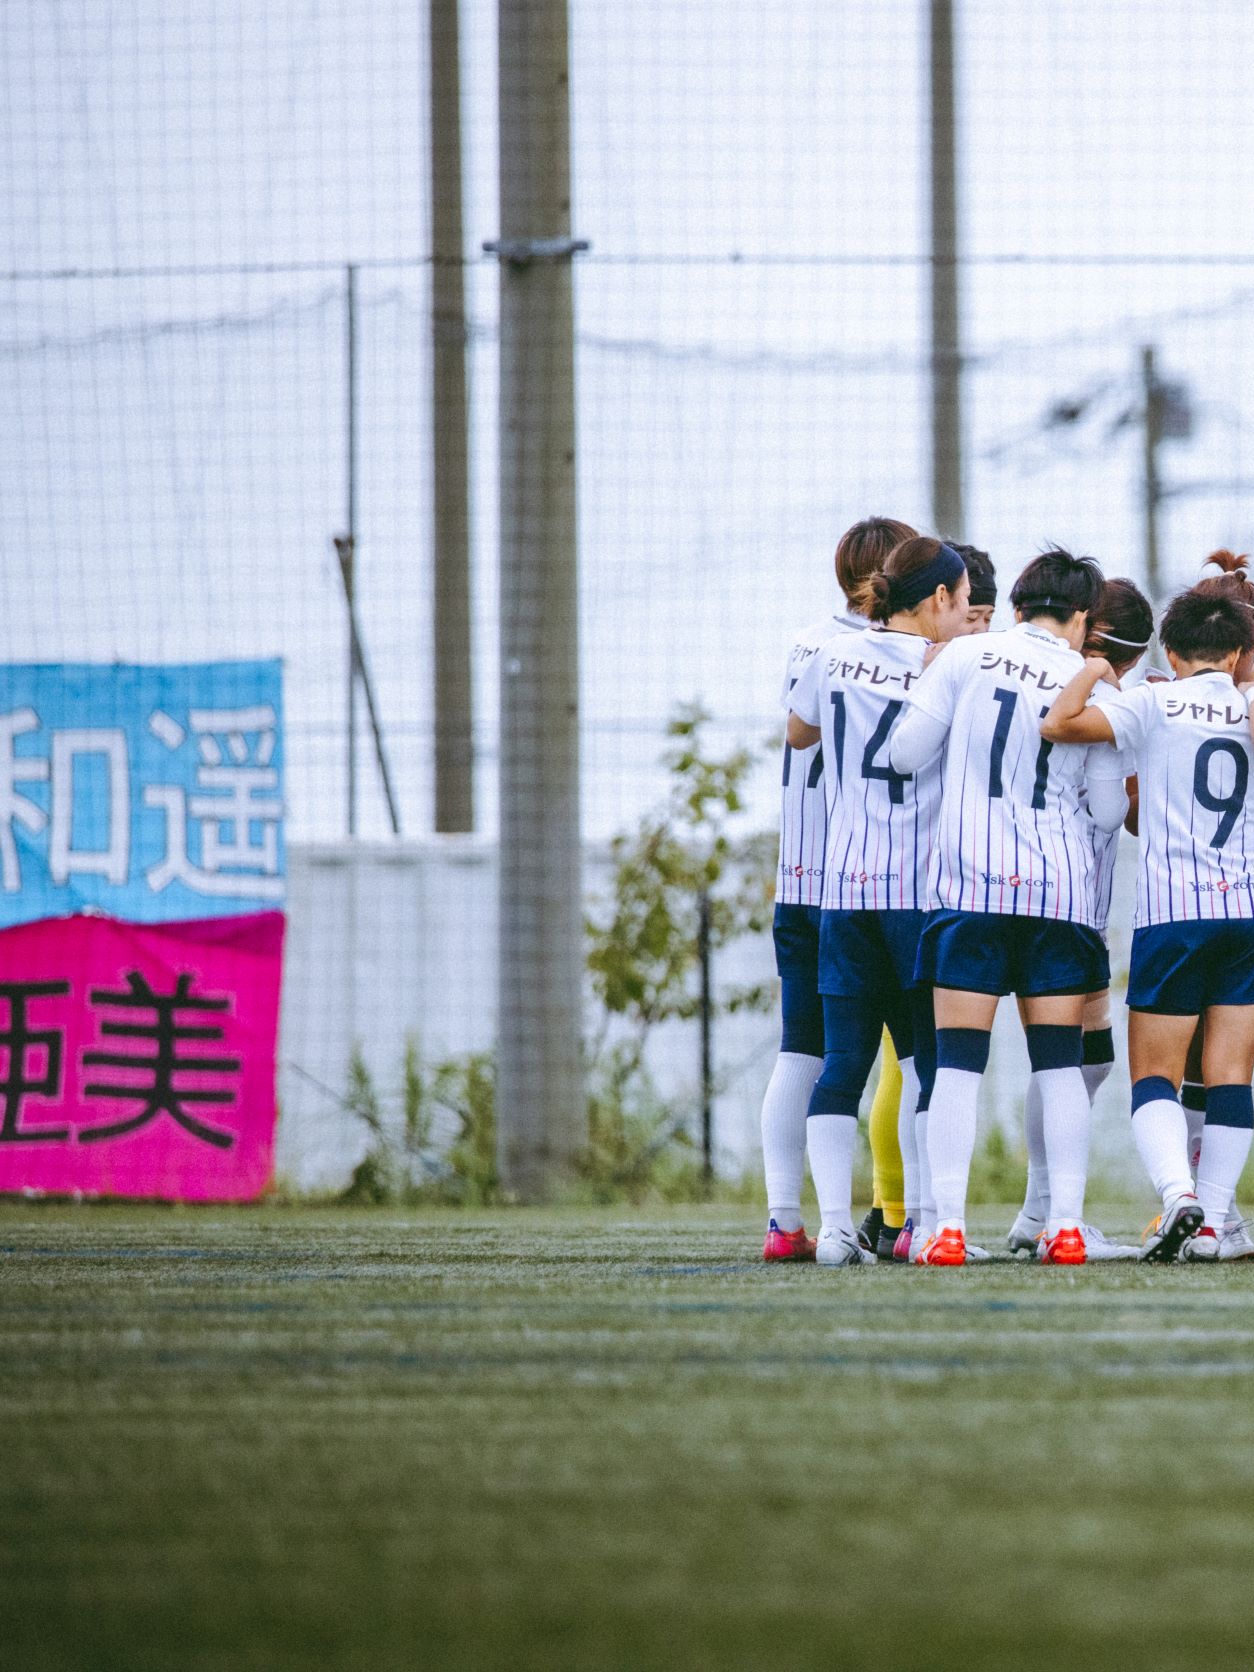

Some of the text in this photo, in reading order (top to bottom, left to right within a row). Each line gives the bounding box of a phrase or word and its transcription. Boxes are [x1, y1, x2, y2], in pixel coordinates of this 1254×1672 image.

[0, 705, 285, 893] 和遥
[830, 691, 913, 804] 14
[1193, 737, 1249, 849] 9
